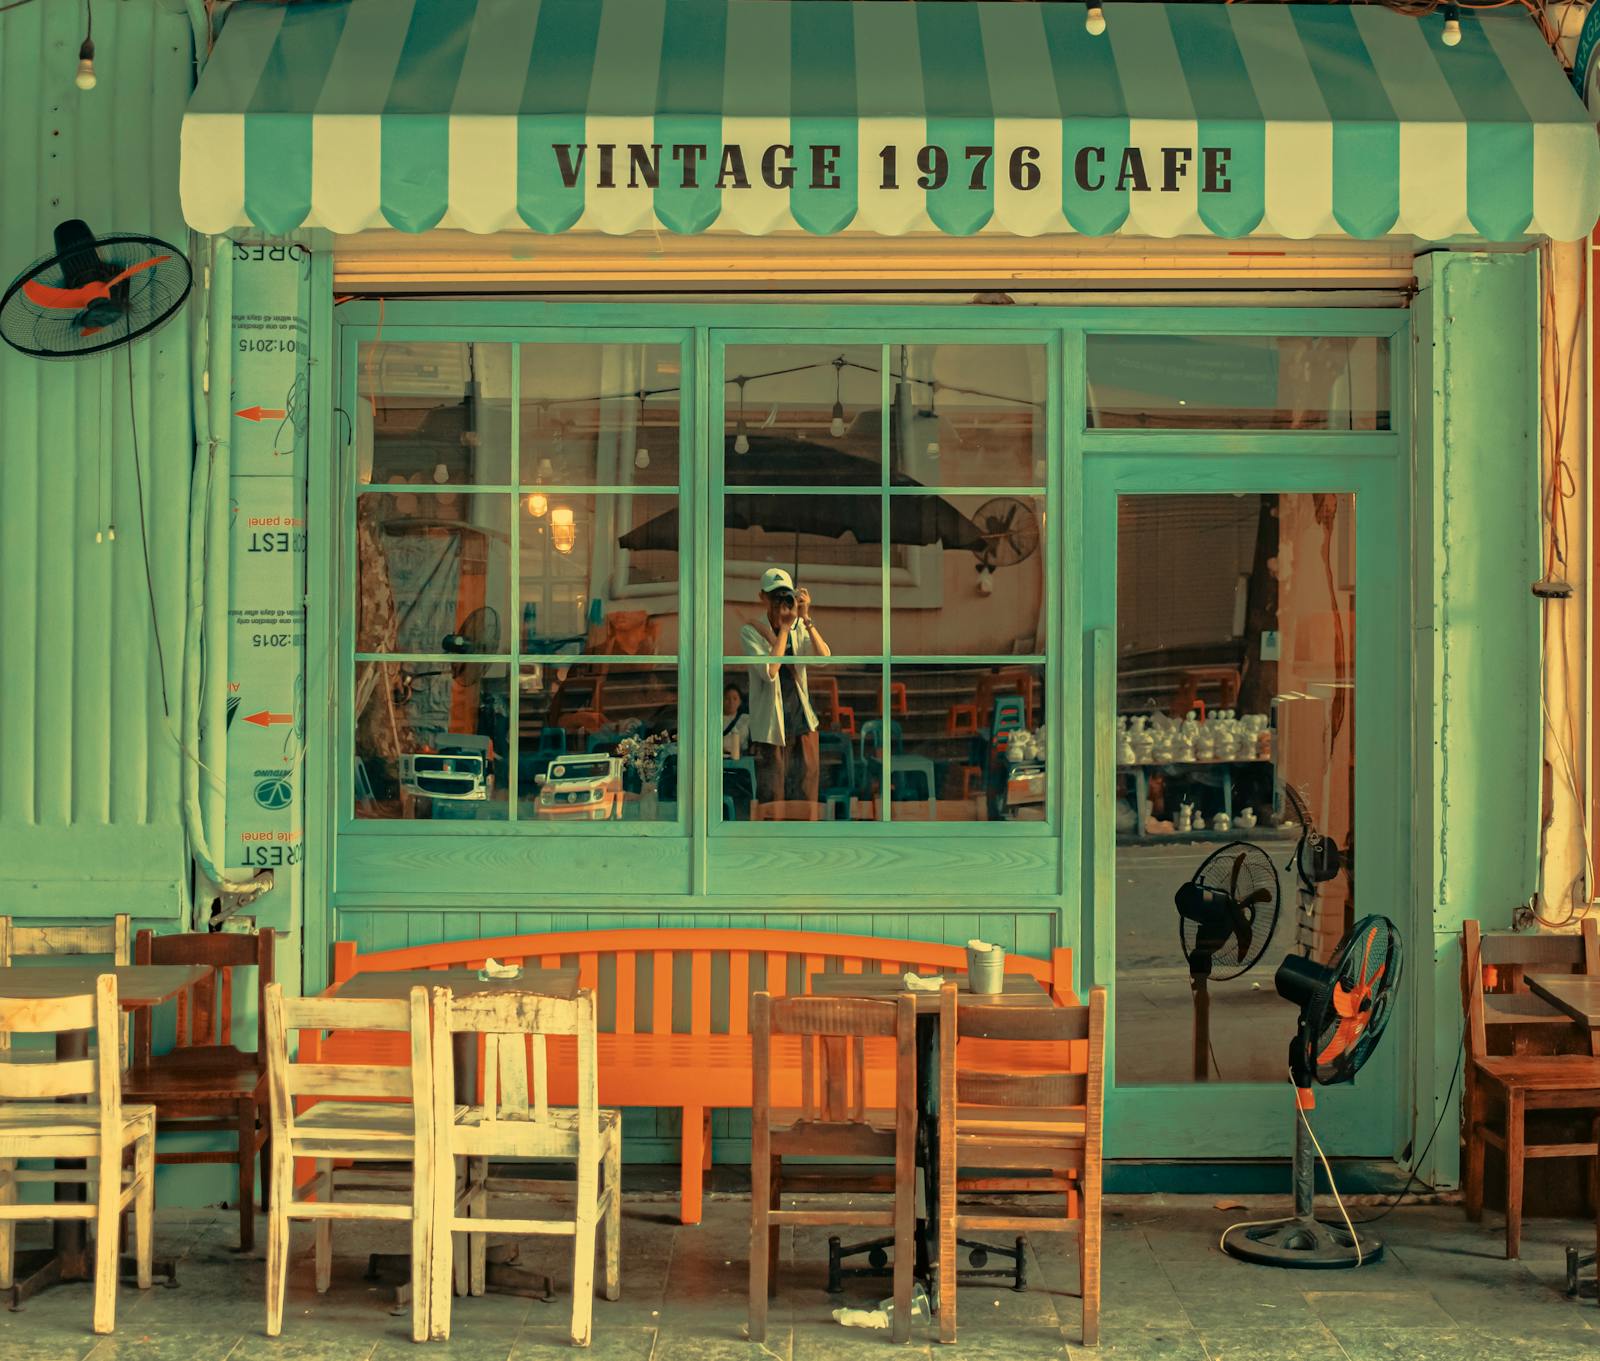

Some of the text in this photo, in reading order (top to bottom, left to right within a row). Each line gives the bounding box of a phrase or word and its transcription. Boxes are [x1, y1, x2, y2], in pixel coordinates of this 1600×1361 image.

[551, 144, 1232, 192] VINTAGE 1976 CAFE
[248, 517, 281, 528] panel
[241, 830, 273, 843] panel
